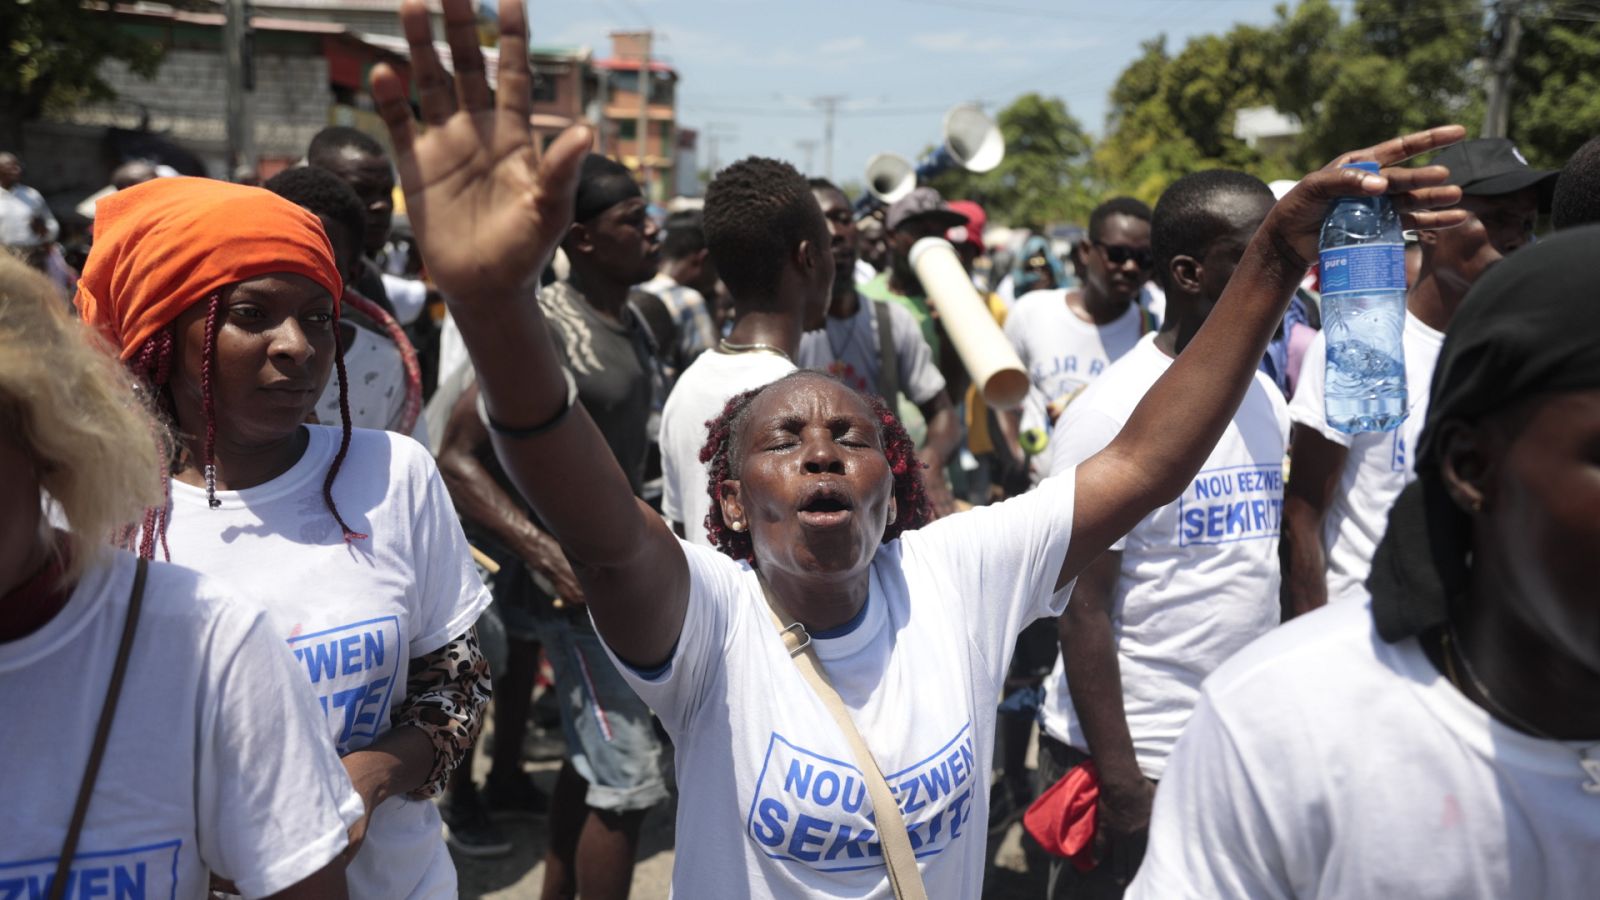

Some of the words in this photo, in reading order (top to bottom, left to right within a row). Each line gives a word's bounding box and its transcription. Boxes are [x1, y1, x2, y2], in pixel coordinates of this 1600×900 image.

[1324, 258, 1348, 272] pure
[1195, 473, 1233, 500] NOU
[1184, 498, 1283, 539] SEKIRIT
[293, 629, 385, 684] WEN
[784, 758, 866, 814] NOU
